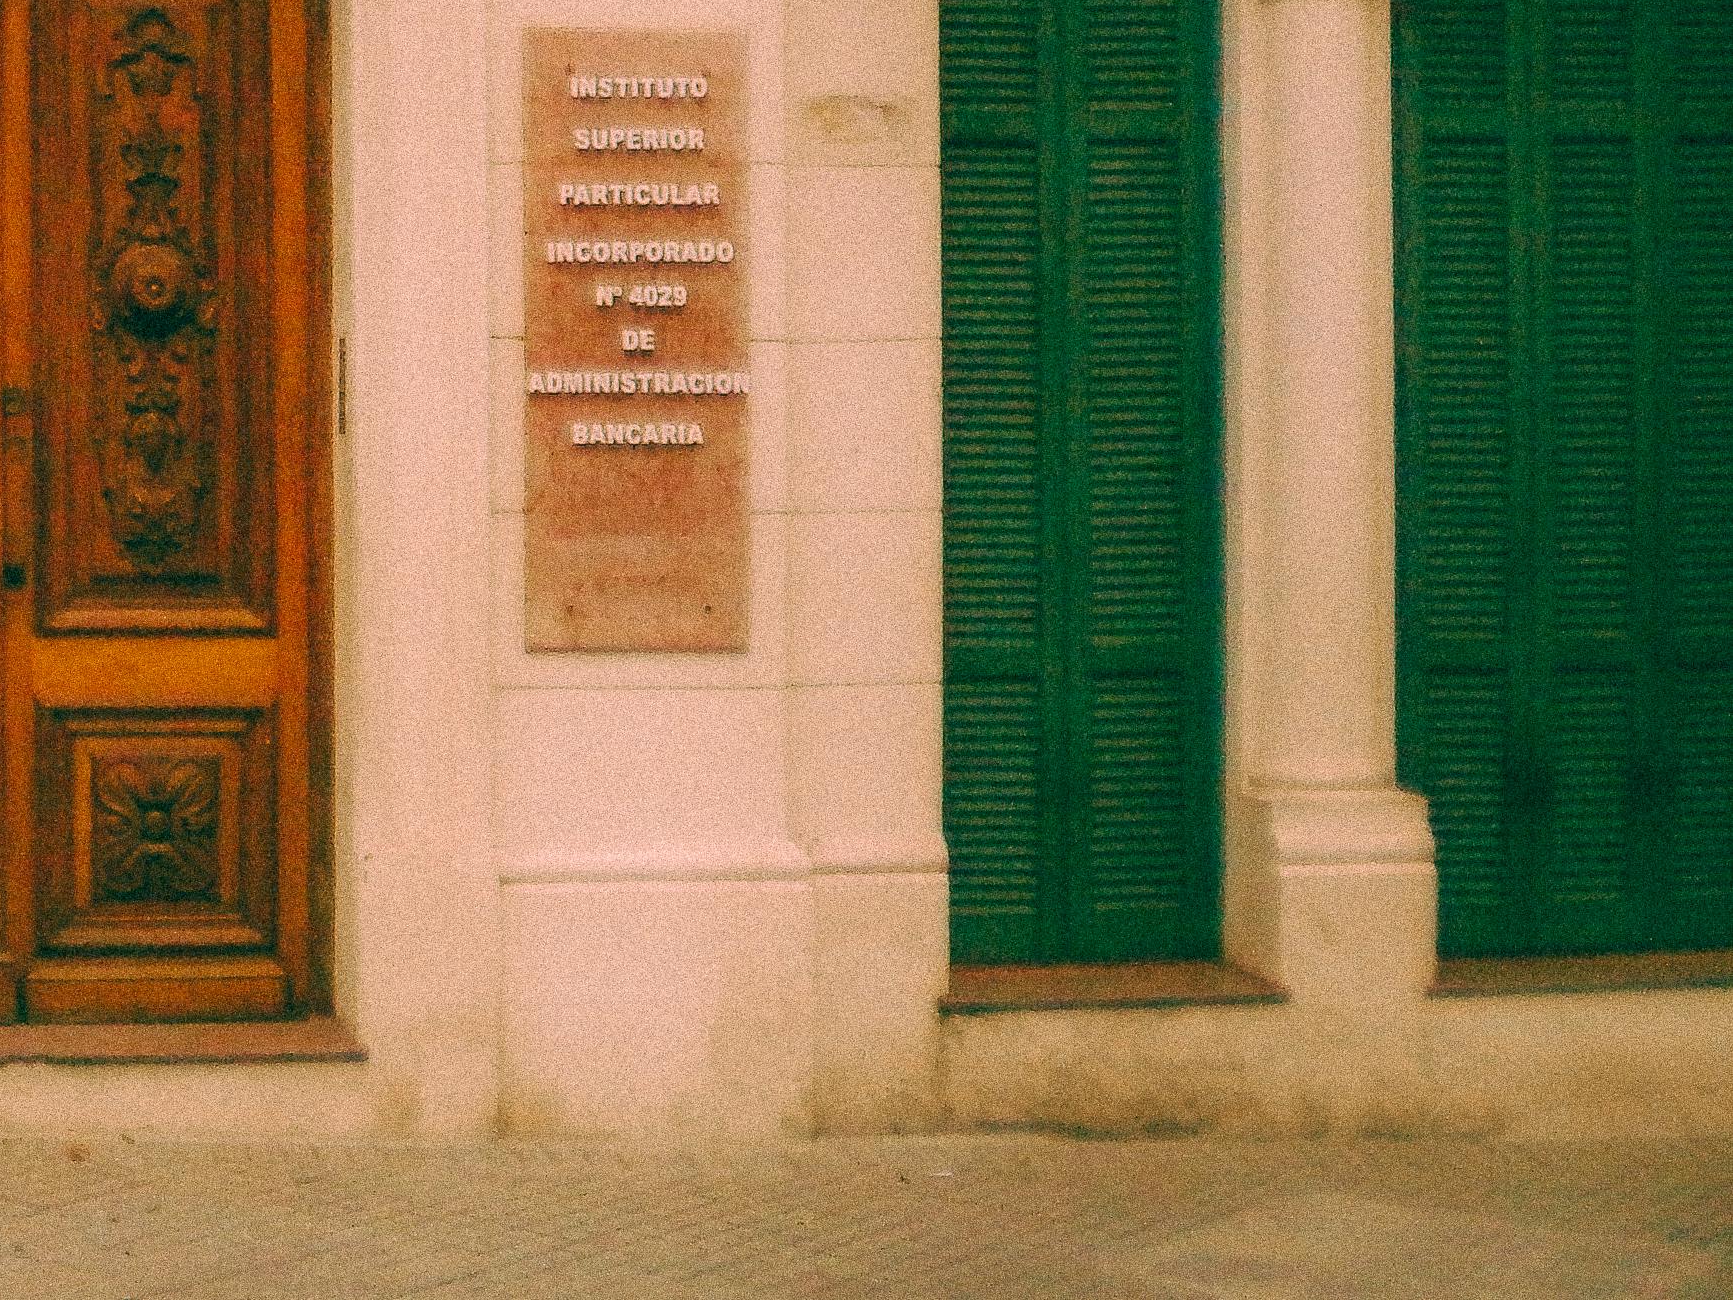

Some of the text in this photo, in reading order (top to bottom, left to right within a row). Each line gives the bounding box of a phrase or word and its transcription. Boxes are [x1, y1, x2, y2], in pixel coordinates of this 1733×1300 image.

[570, 76, 708, 99] INSTITUTO
[574, 128, 705, 151] SUPERIOR
[560, 182, 720, 206] PARTICULAR
[547, 241, 735, 264] INCORPORADO
[629, 284, 687, 308] 4029
[622, 329, 656, 352] DE
[529, 371, 752, 395] ADMINISTRACION
[572, 422, 705, 446] BANCARIA
